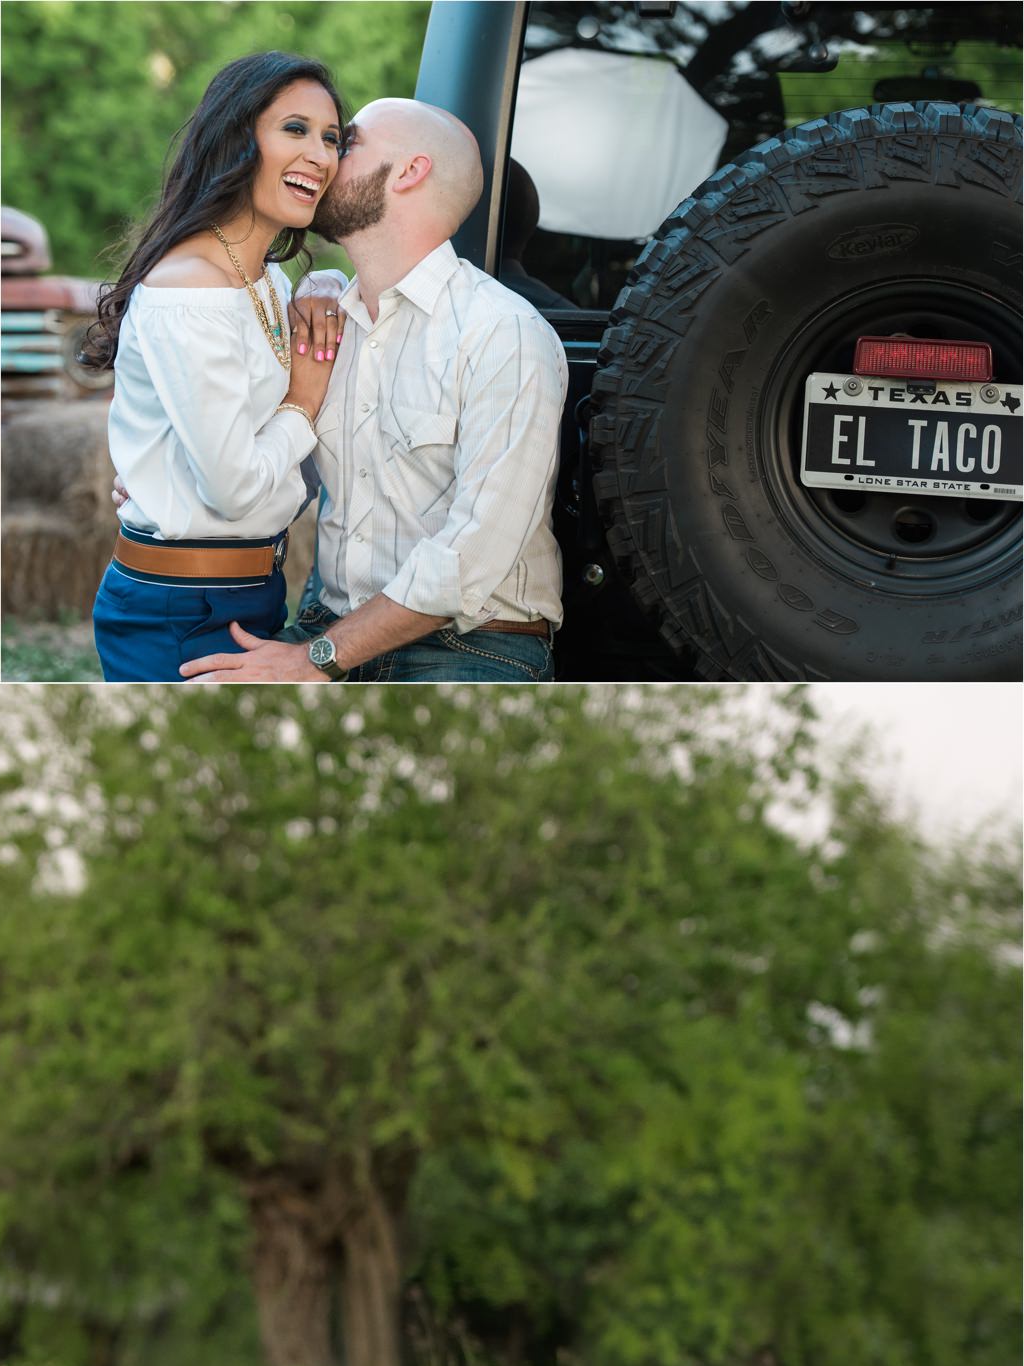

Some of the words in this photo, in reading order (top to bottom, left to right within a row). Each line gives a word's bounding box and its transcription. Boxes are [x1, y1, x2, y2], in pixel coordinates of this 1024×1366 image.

[868, 386, 972, 407] TEXAS
[831, 414, 876, 467] EL
[908, 419, 1002, 475] TACO
[707, 300, 860, 636] GOODYEAR
[858, 476, 891, 486] LONE
[896, 479, 928, 488] STAR
[932, 482, 971, 491] STATE
